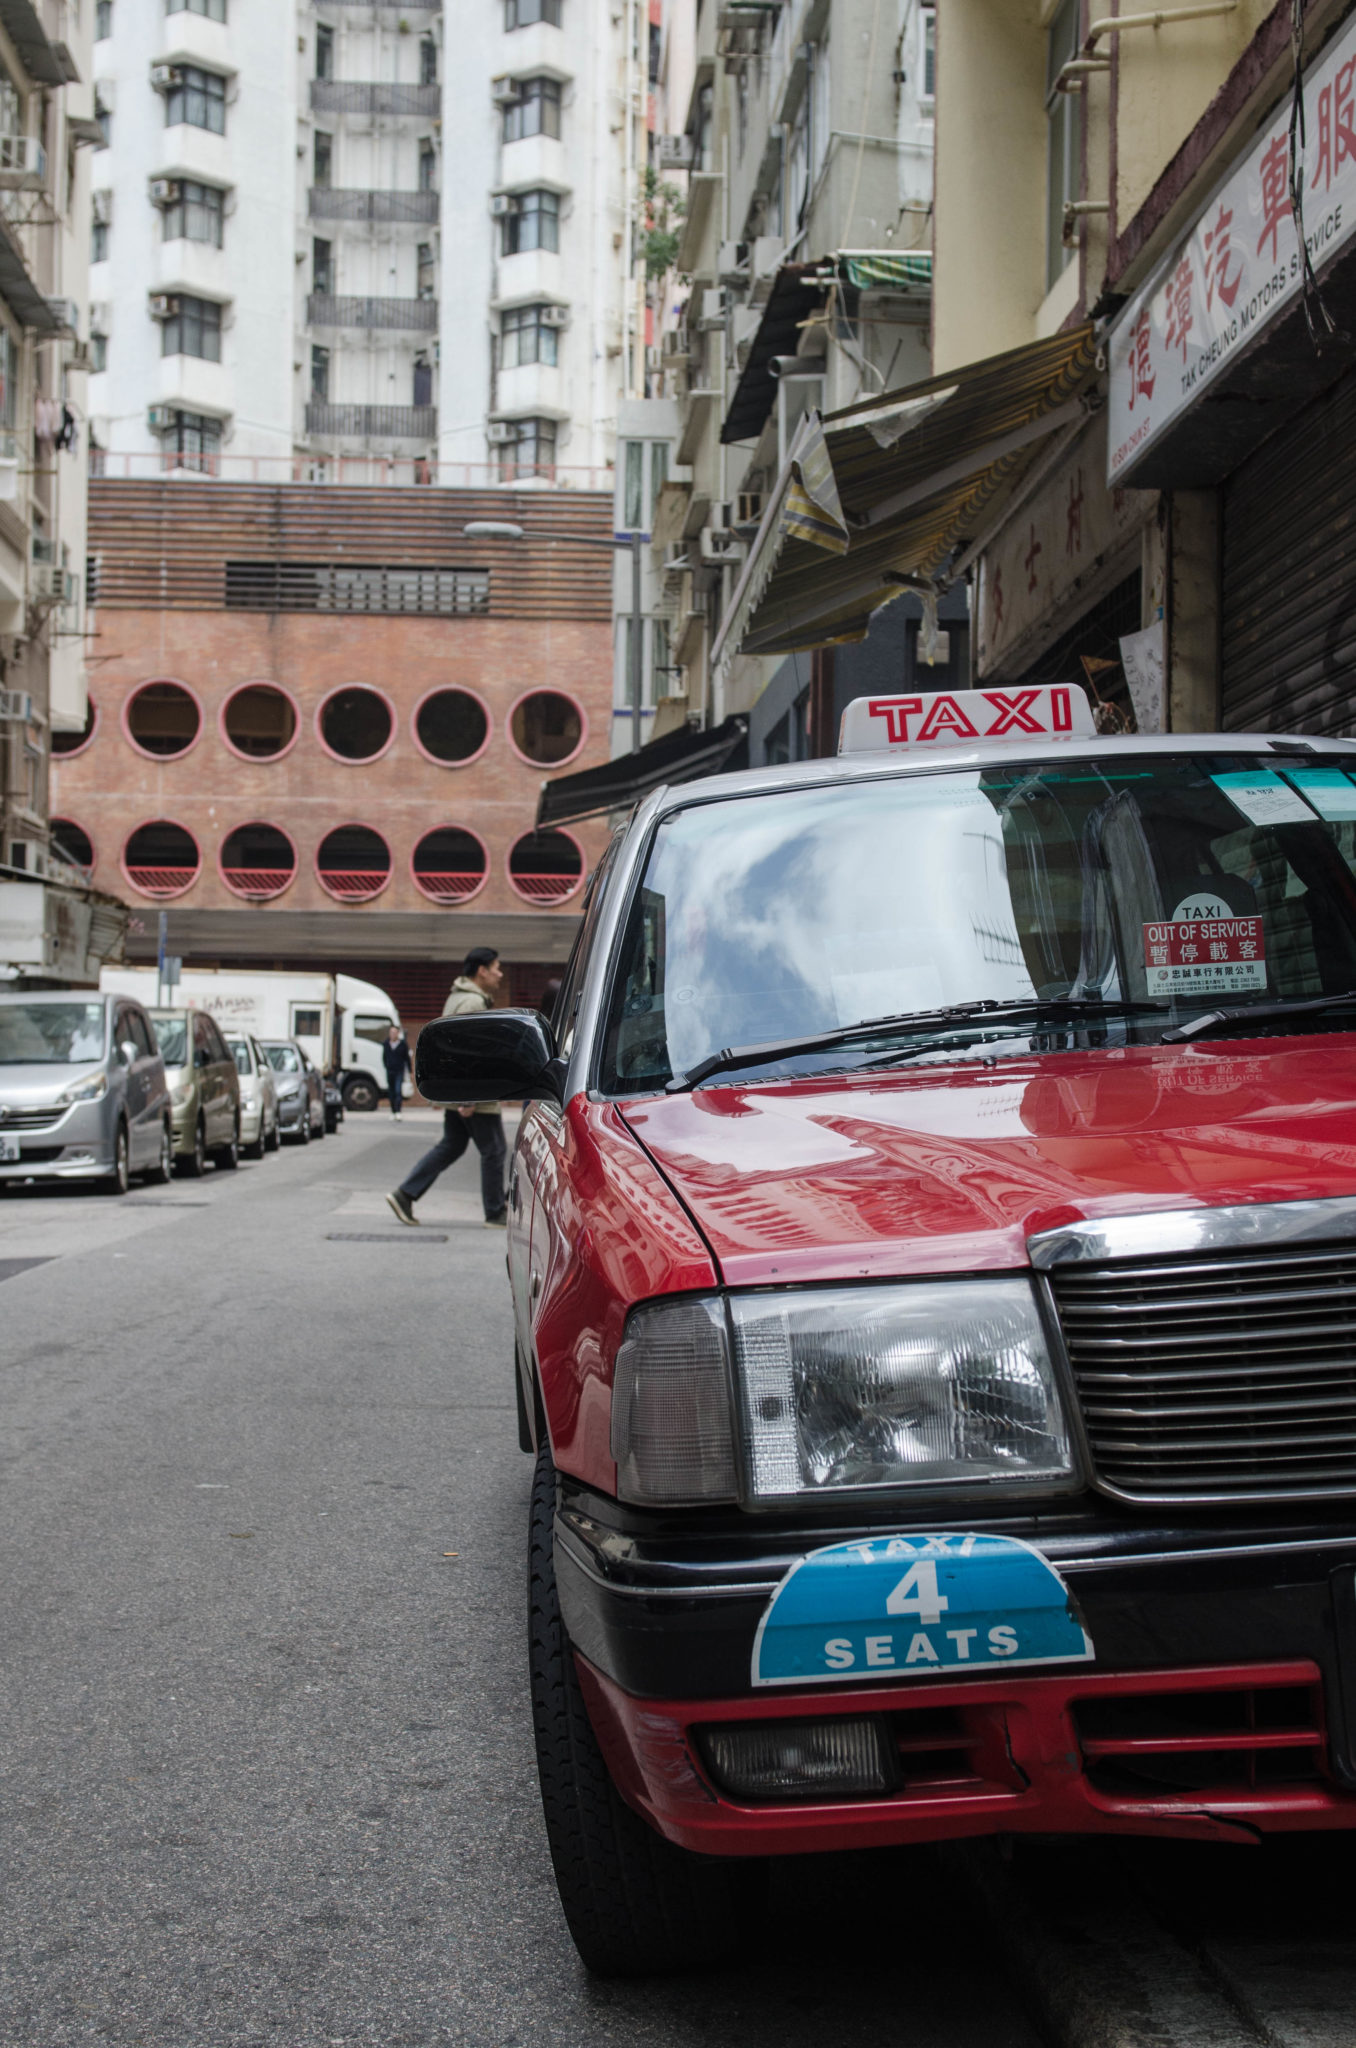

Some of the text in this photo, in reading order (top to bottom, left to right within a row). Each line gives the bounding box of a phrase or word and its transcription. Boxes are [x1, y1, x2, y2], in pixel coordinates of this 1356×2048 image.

[1181, 364, 1197, 395] TAK
[1199, 319, 1238, 377] CHEUNG
[1240, 266, 1286, 331] MOTORS
[868, 688, 1073, 743] TAXI
[1182, 905, 1221, 920] TAXI
[1148, 920, 1257, 943] OUT OF SERVICE
[1149, 939, 1258, 965] 暫停載客
[1171, 965, 1255, 979] 忠誠車行有限公司
[847, 1536, 977, 1564] TAXI
[886, 1559, 949, 1626] 4
[824, 1625, 1019, 1669] SEATS
